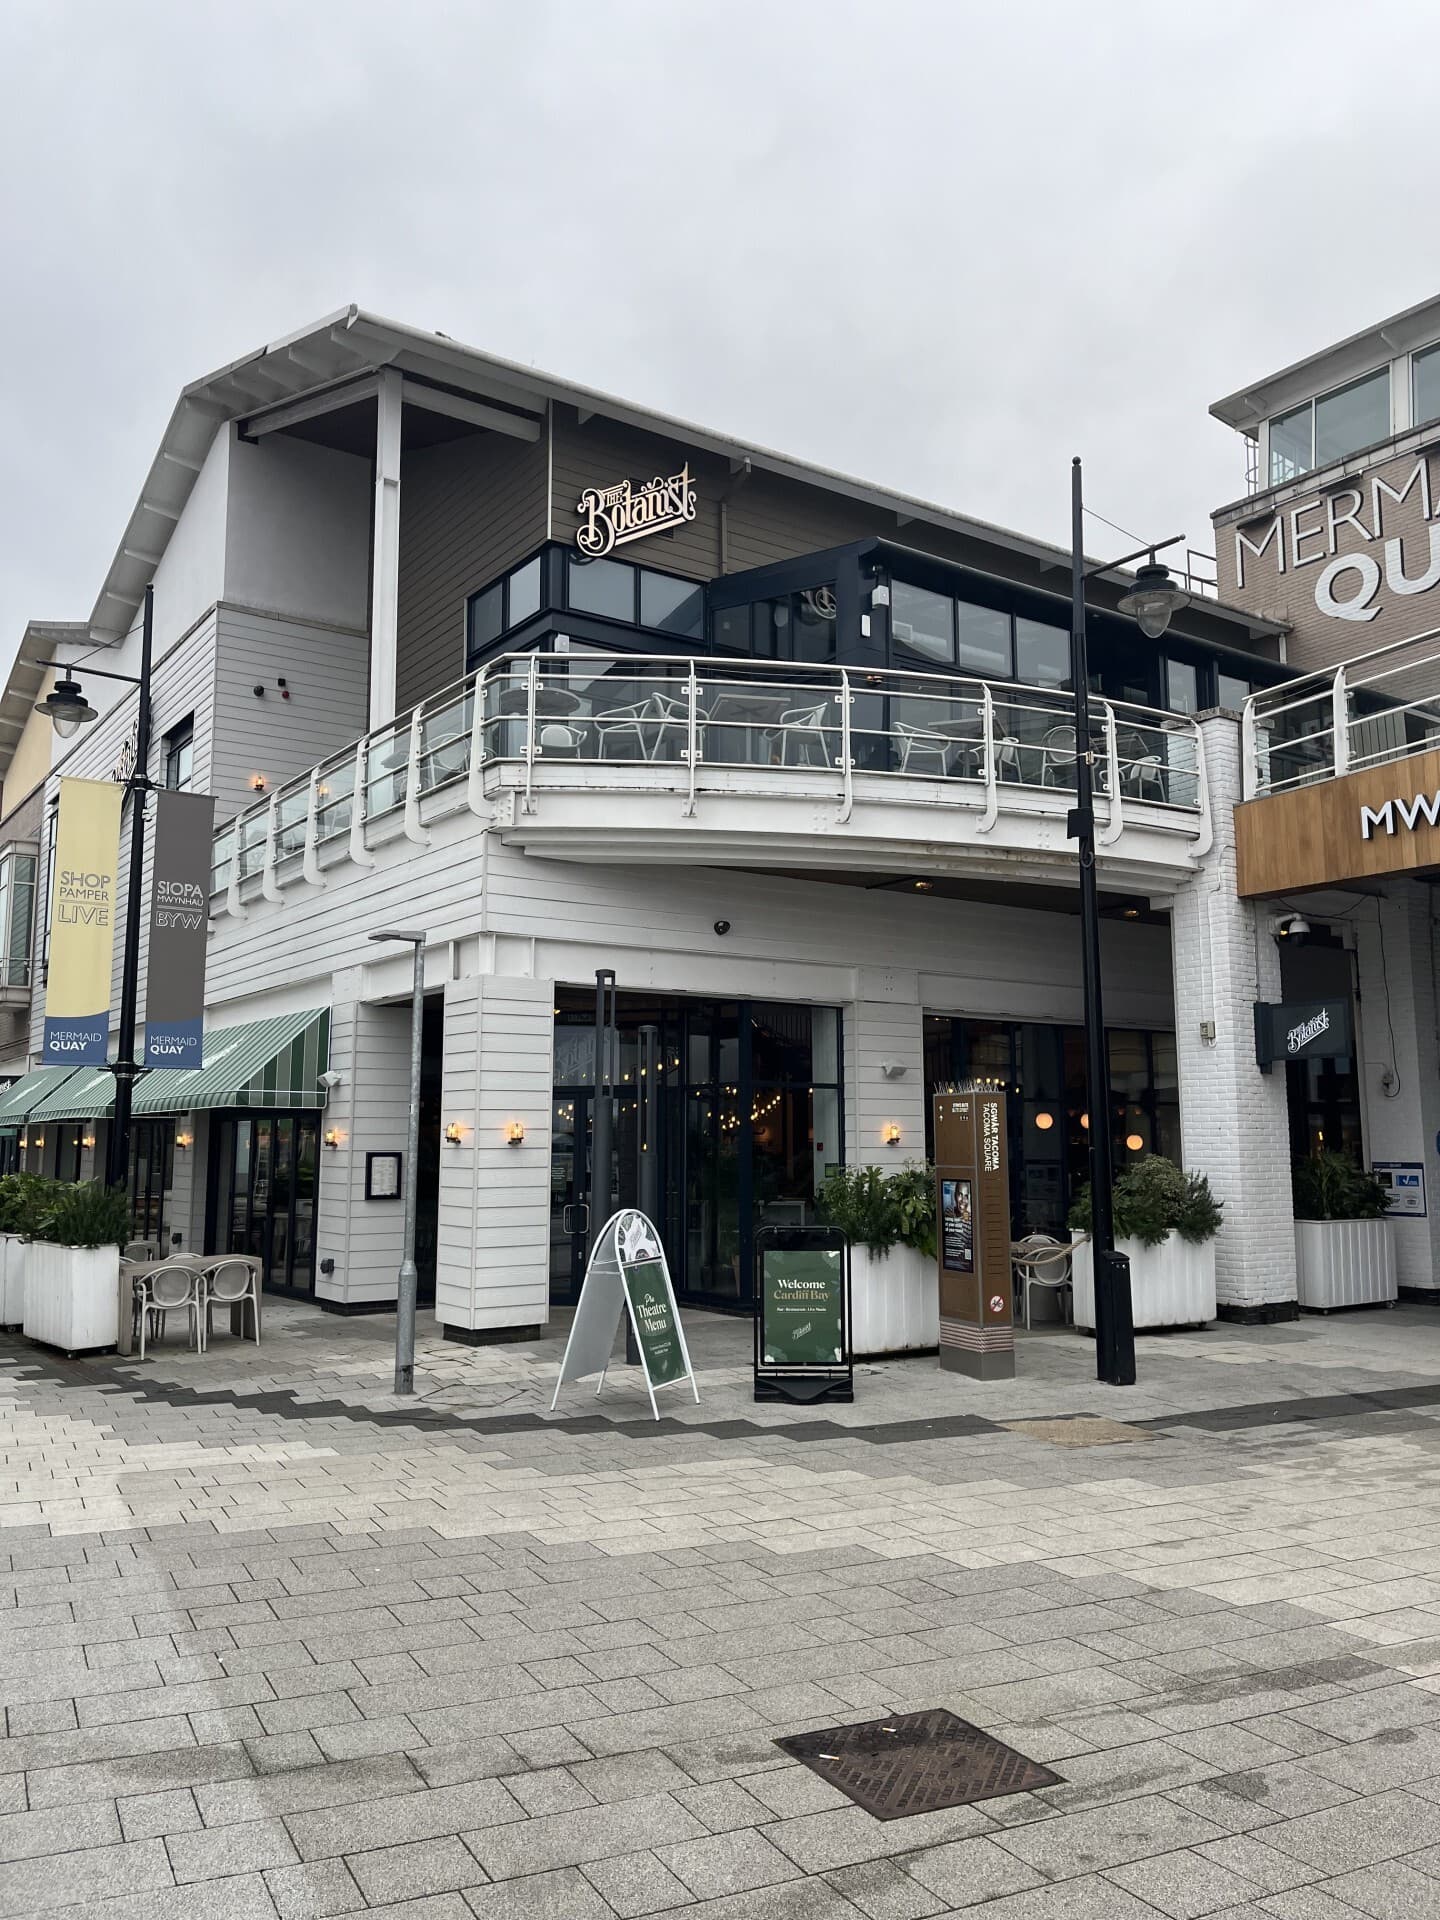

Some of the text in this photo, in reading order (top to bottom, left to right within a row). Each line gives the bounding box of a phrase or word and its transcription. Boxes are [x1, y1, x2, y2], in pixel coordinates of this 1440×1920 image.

[604, 490, 624, 508] THE
[577, 461, 697, 557] Botanist
[1235, 457, 1440, 588] MERM
[60, 870, 111, 888] SHOP
[59, 886, 109, 901] PAMPER
[157, 880, 203, 898] SIOPA
[157, 895, 203, 906] MWYNHAU
[58, 904, 109, 926] LIVE
[156, 911, 202, 929] BYW
[50, 1031, 102, 1042] MERMAID
[150, 1035, 197, 1046] MERMAID
[50, 1041, 87, 1051] QUAY
[150, 1045, 184, 1055] QUAY
[983, 1102, 992, 1172] TACOMA SQUARE
[991, 1135, 1000, 1171] TACOMA
[777, 1279, 826, 1289] Welcome
[810, 1289, 829, 1302] Bay
[636, 1303, 667, 1318] Theatre
[644, 1318, 667, 1332] Menu
